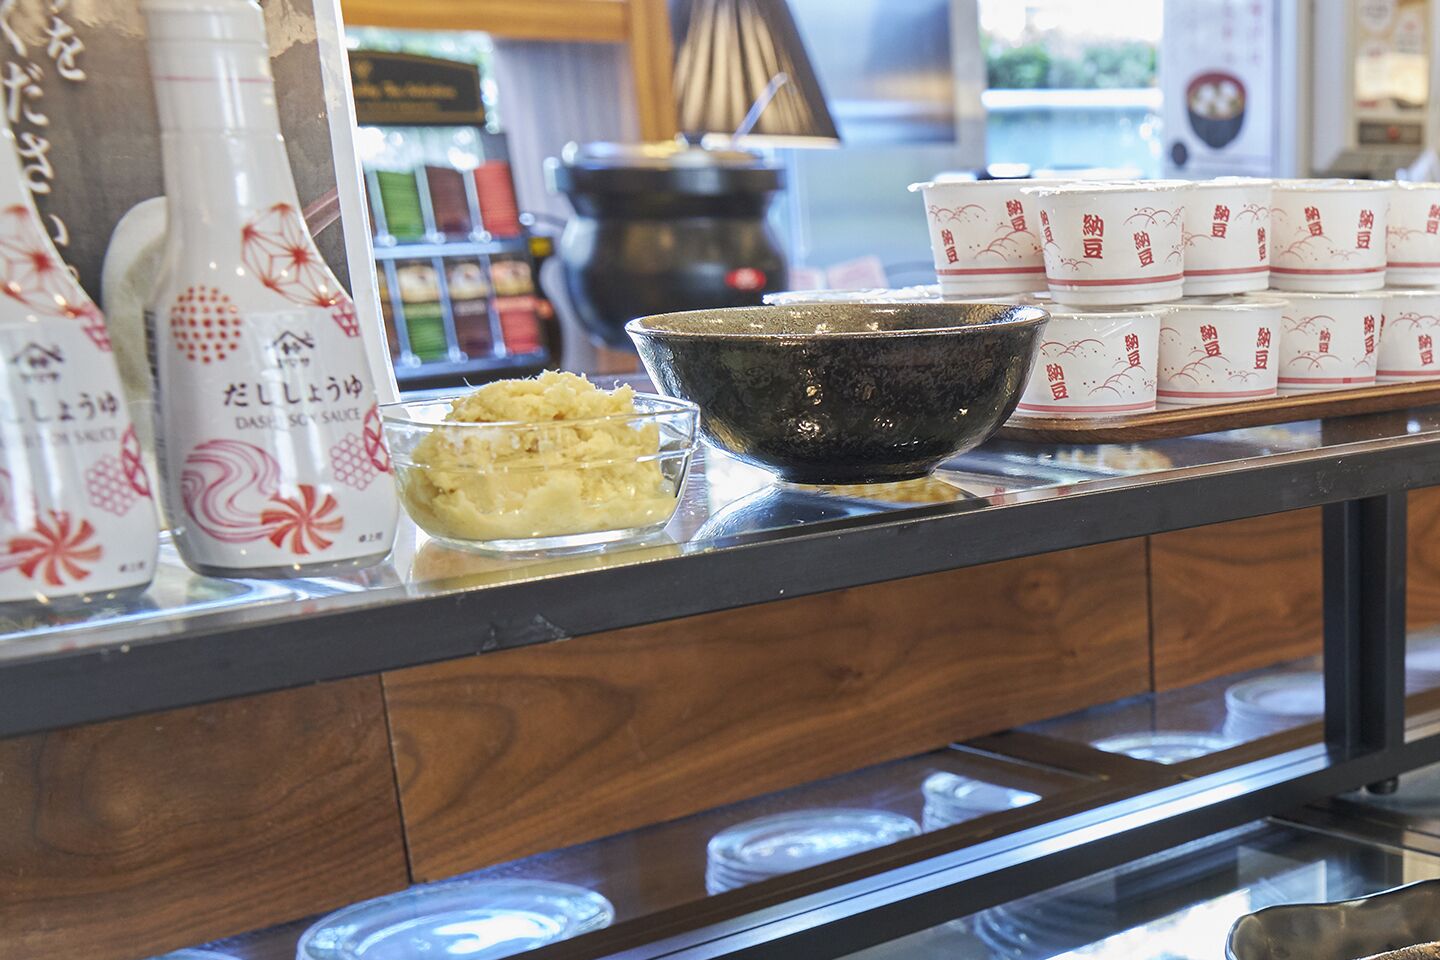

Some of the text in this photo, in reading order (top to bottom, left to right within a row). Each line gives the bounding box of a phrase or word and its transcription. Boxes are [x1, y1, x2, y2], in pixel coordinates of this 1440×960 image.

[1006, 199, 1027, 232] 納豆
[1040, 209, 1054, 244] 納豆
[1211, 204, 1230, 239] 納豆
[1305, 205, 1323, 237] 納豆
[1356, 209, 1374, 249] 納豆
[941, 228, 959, 264] 納豆
[1083, 214, 1105, 260] 納豆
[1133, 230, 1154, 268] 納豆
[1124, 333, 1141, 368] 納豆
[1200, 324, 1221, 358] 納豆
[1254, 326, 1271, 370] 納豆
[1319, 327, 1331, 353] 納豆
[1364, 314, 1375, 355] 納豆
[1418, 334, 1434, 367] 納豆
[224, 374, 363, 407] だししょうゆ
[1046, 363, 1068, 401] 納豆
[321, 407, 361, 424] SAUCE
